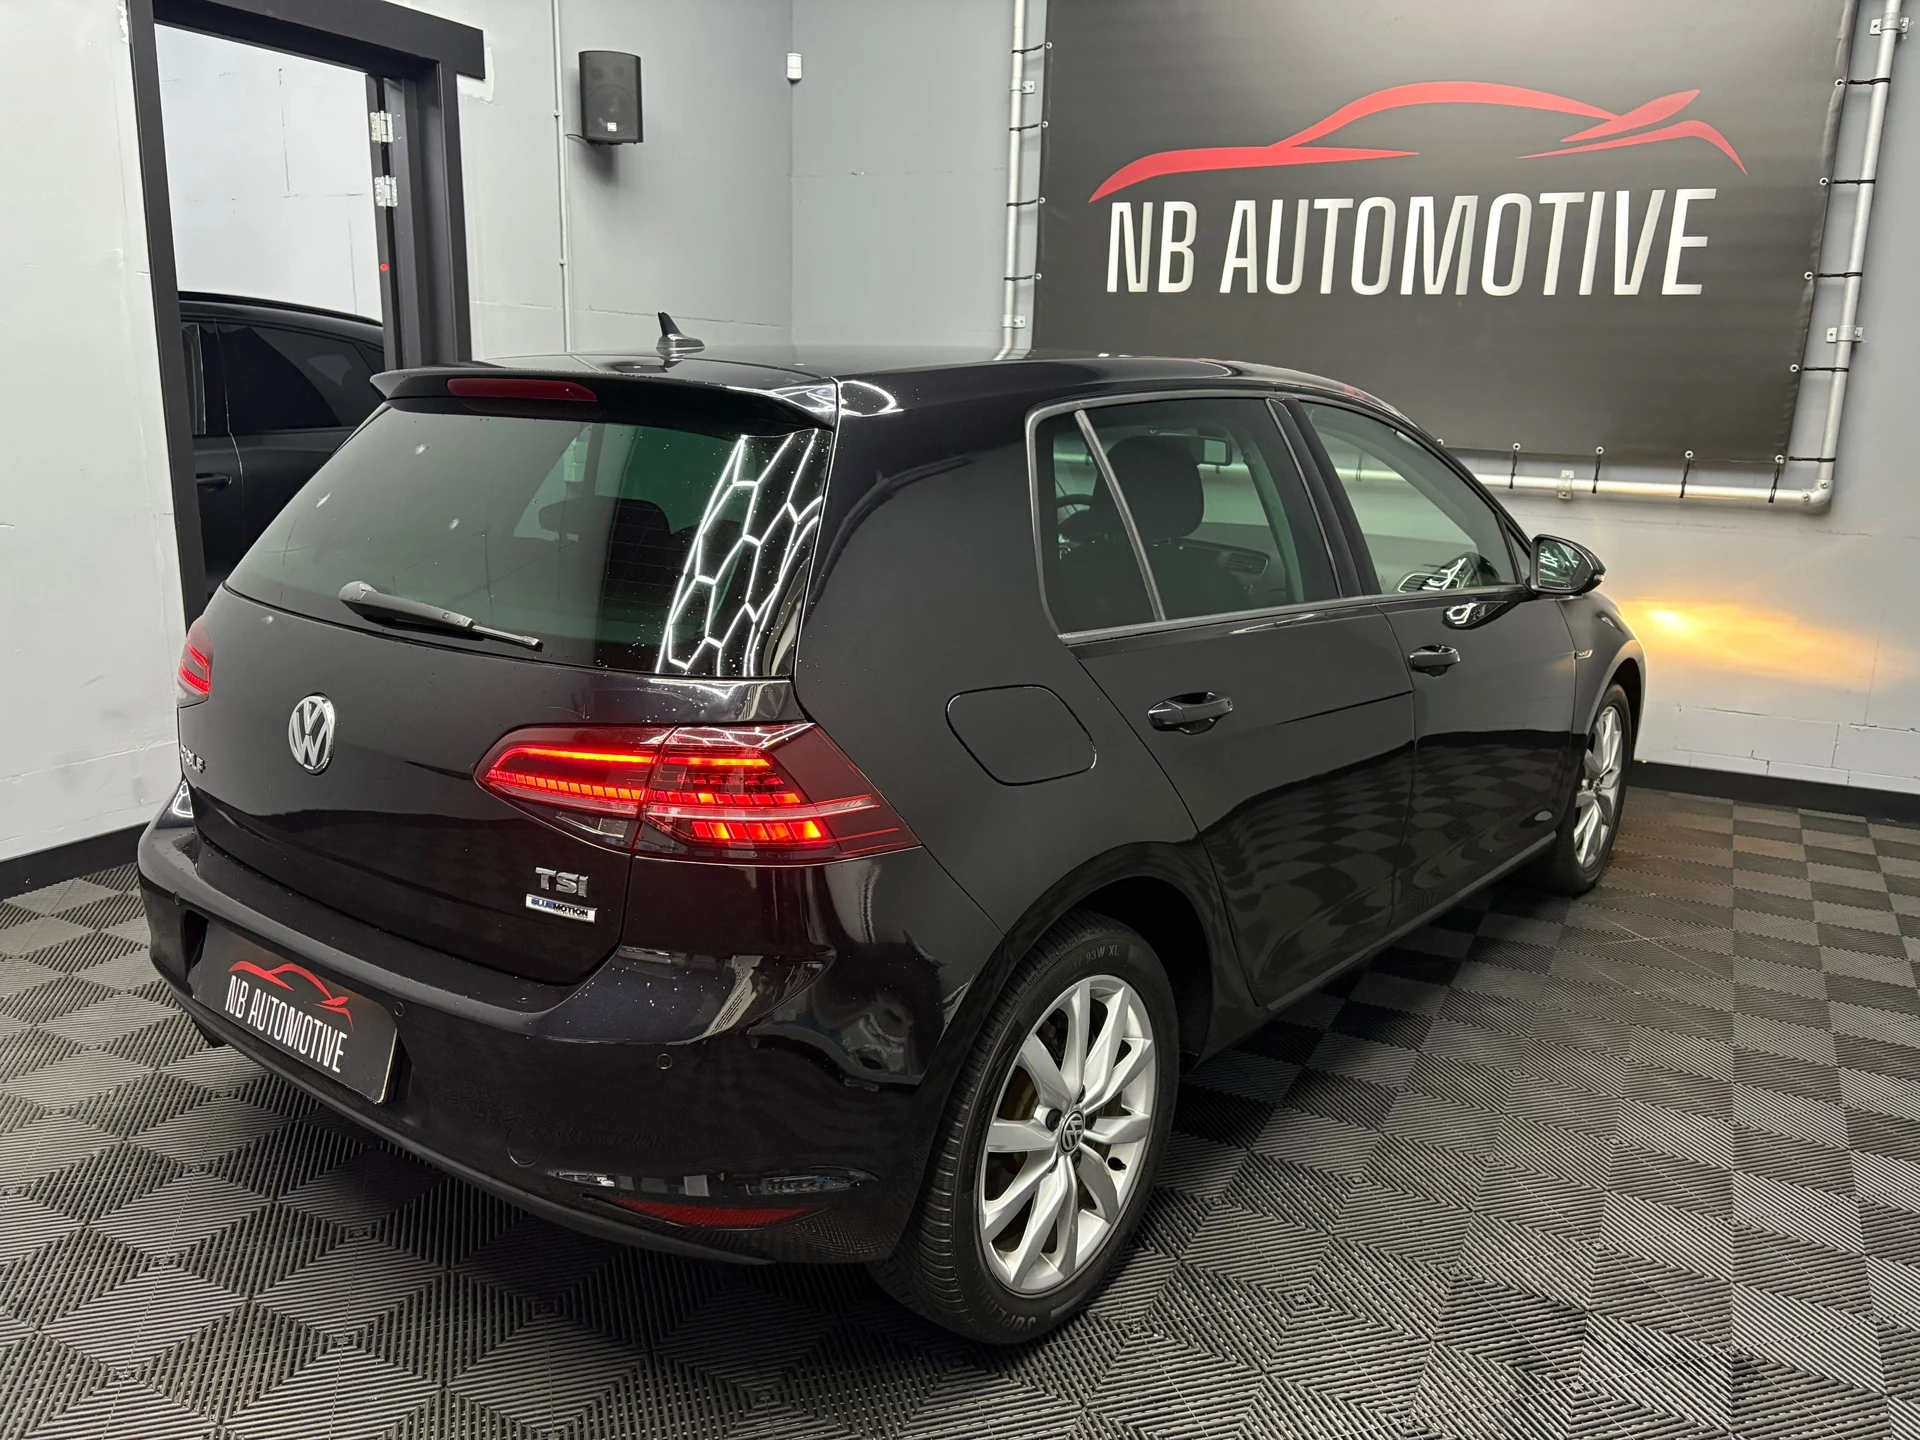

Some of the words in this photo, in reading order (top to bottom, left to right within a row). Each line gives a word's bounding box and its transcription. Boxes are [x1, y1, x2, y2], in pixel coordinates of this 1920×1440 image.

[1106, 200, 1197, 293] NB
[1219, 188, 1717, 296] AUTOMOTIVE
[535, 866, 589, 898] TSI
[1085, 945, 1106, 962] 93W
[1109, 944, 1120, 957] XL
[225, 974, 249, 1019] NB
[247, 988, 348, 1074] AUTOMOTIVE
